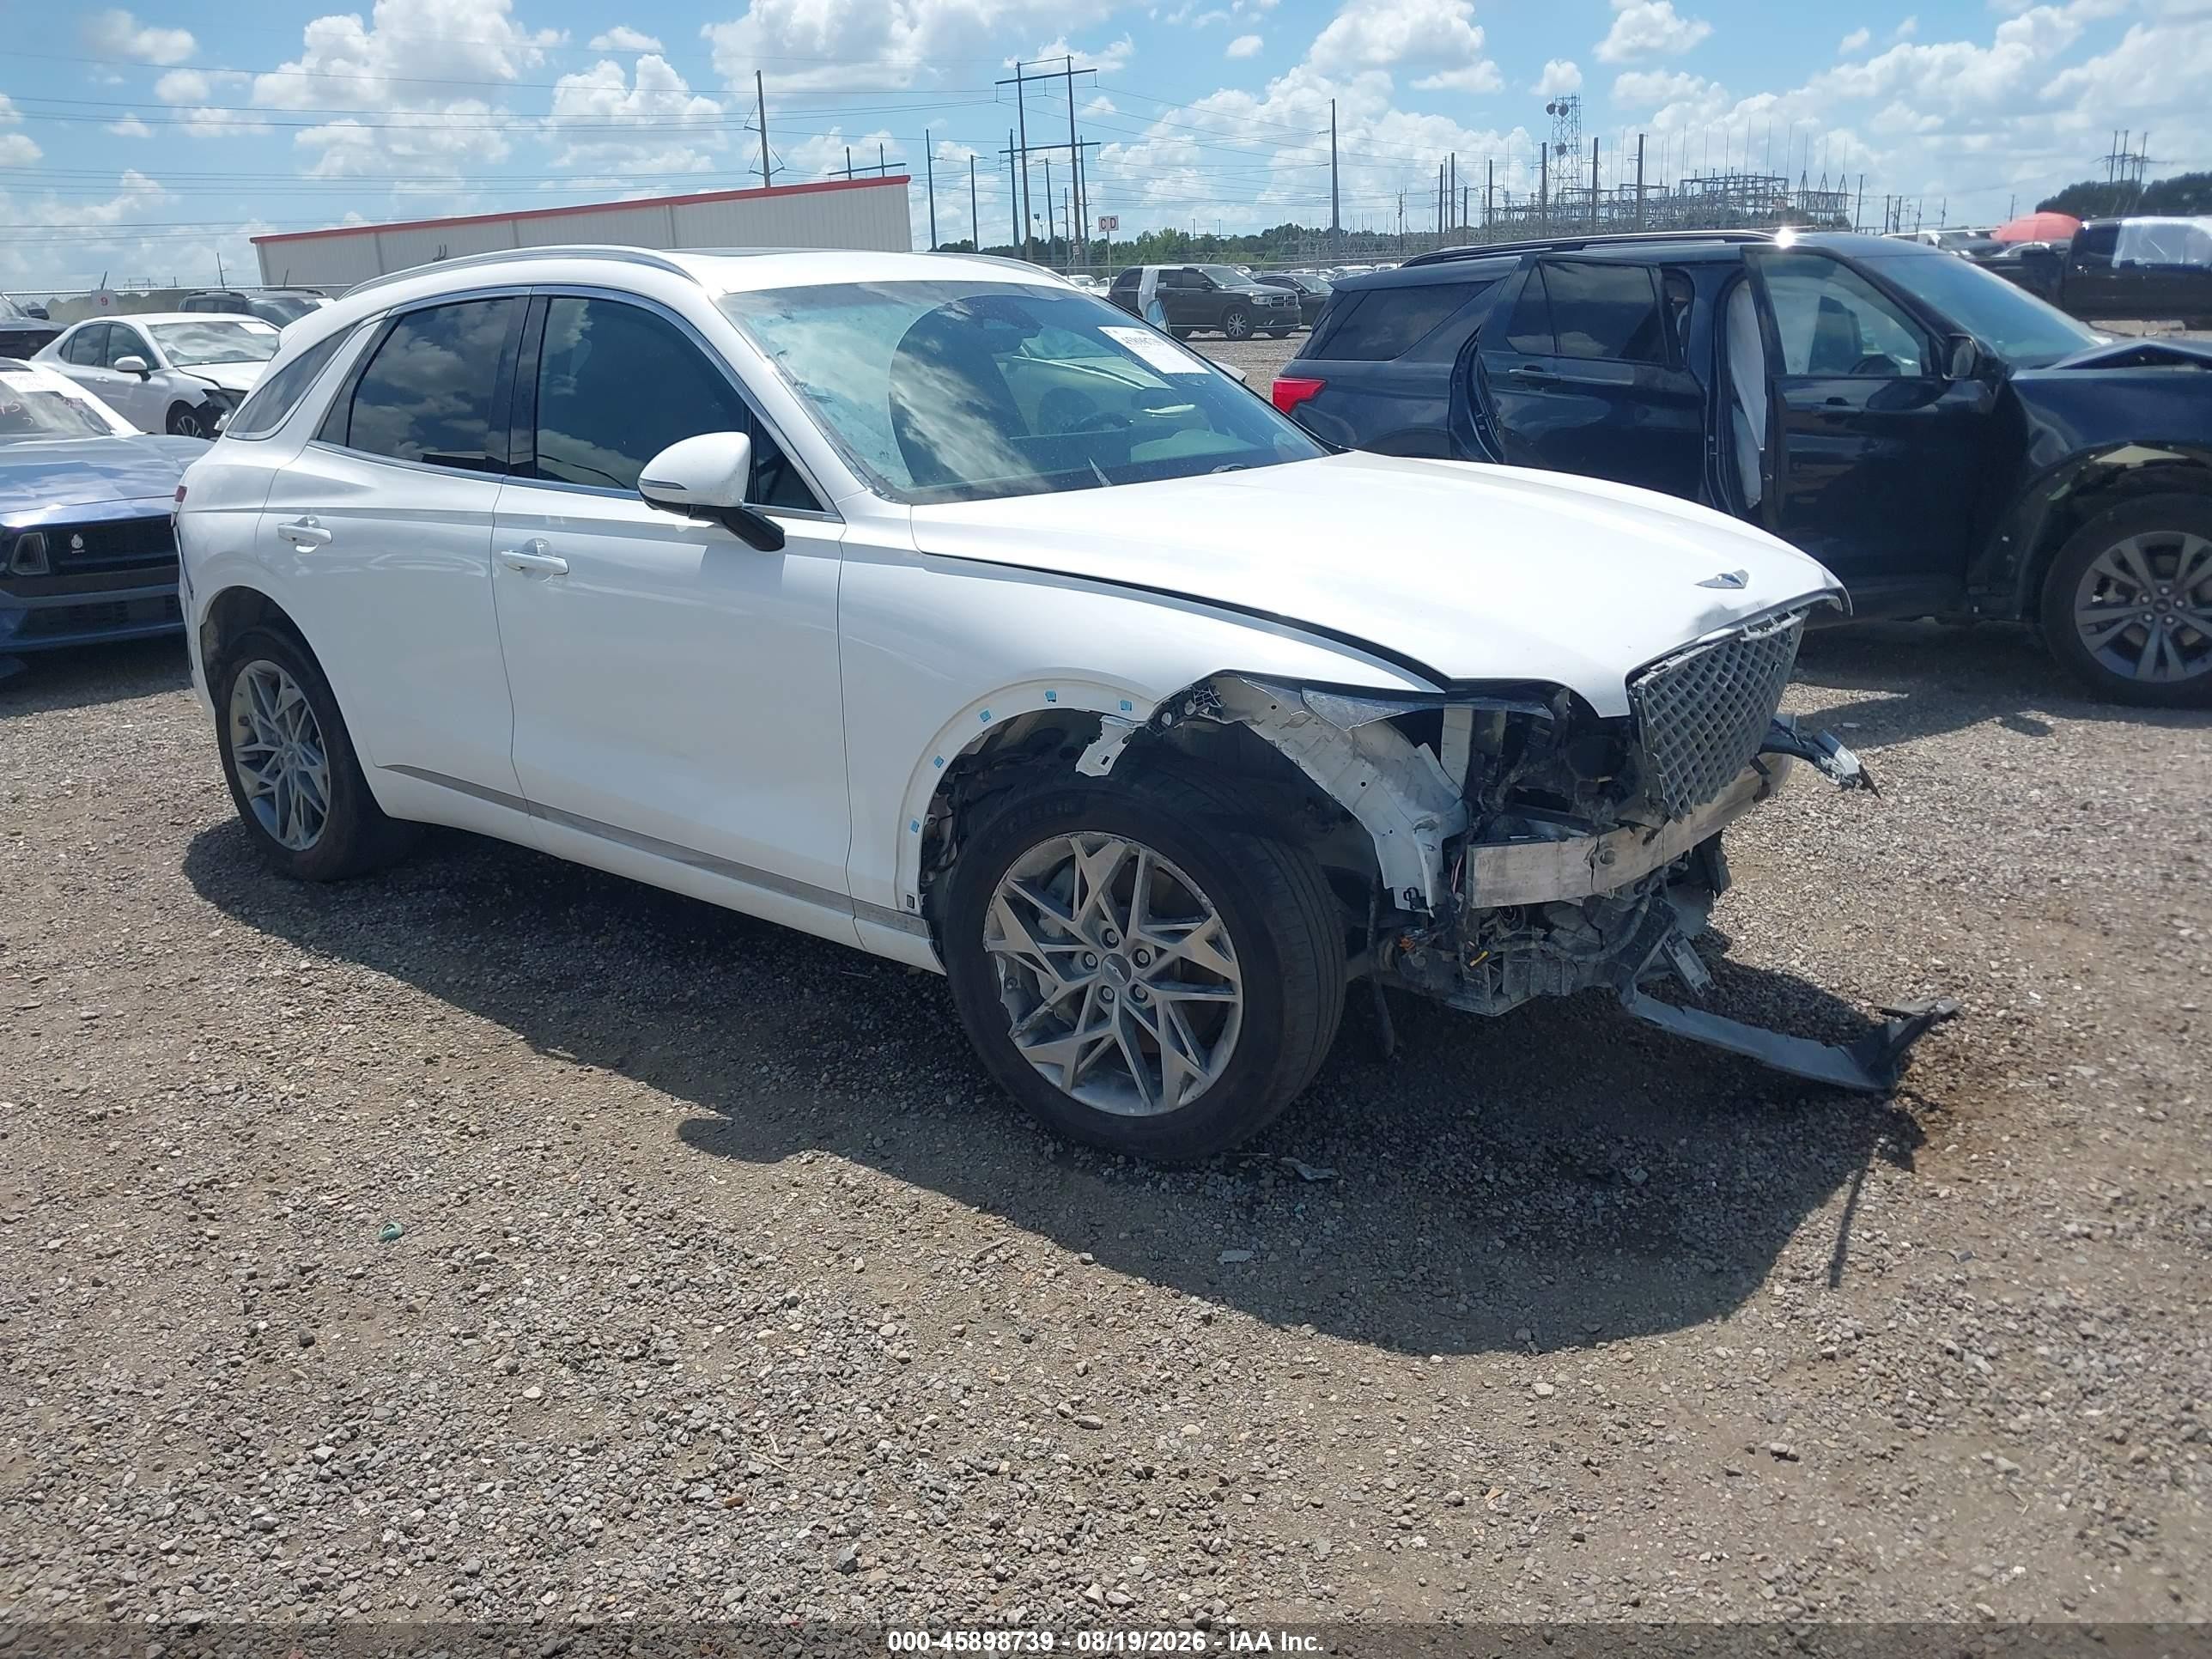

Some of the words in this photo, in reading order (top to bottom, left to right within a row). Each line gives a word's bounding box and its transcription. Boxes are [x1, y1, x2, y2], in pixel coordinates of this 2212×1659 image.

[1100, 218, 1107, 230] C
[1109, 217, 1117, 229] D
[100, 296, 108, 307] 9
